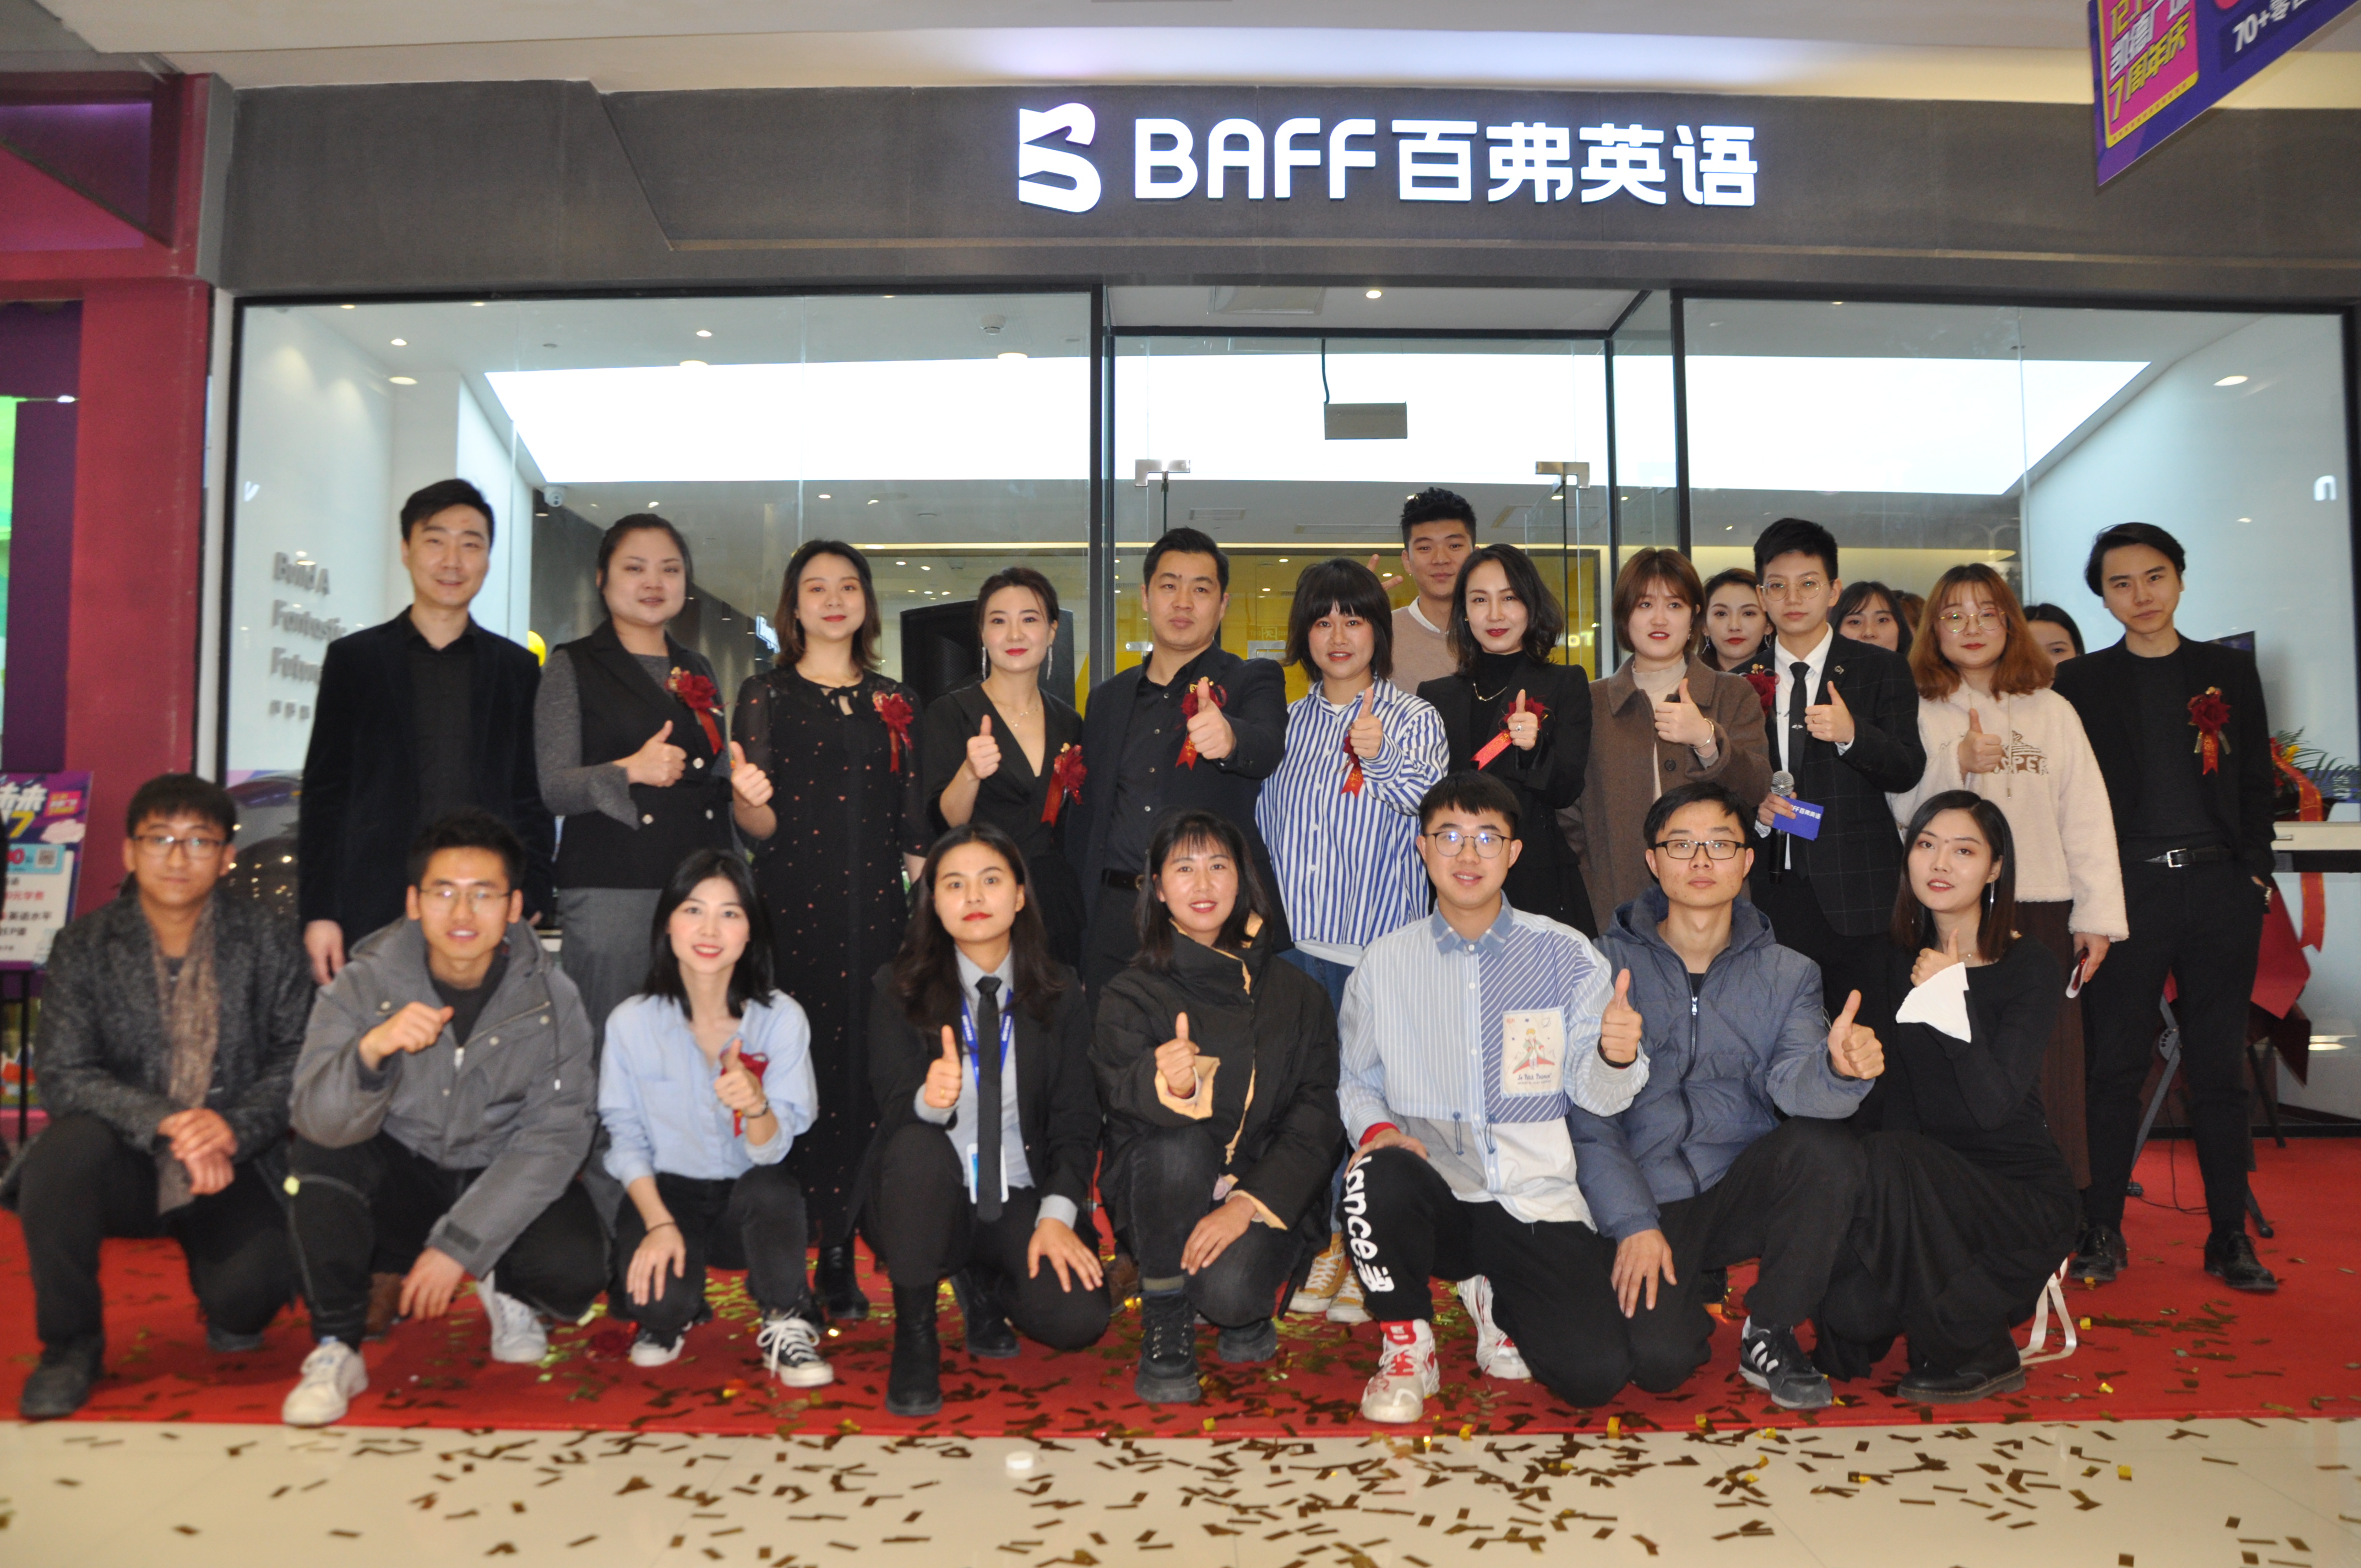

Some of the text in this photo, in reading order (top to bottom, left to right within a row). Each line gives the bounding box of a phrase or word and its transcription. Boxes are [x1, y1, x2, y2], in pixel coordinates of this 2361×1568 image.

[2109, 9, 2191, 123] 7周年庆
[1134, 117, 1758, 207] BAFF 百弗英语
